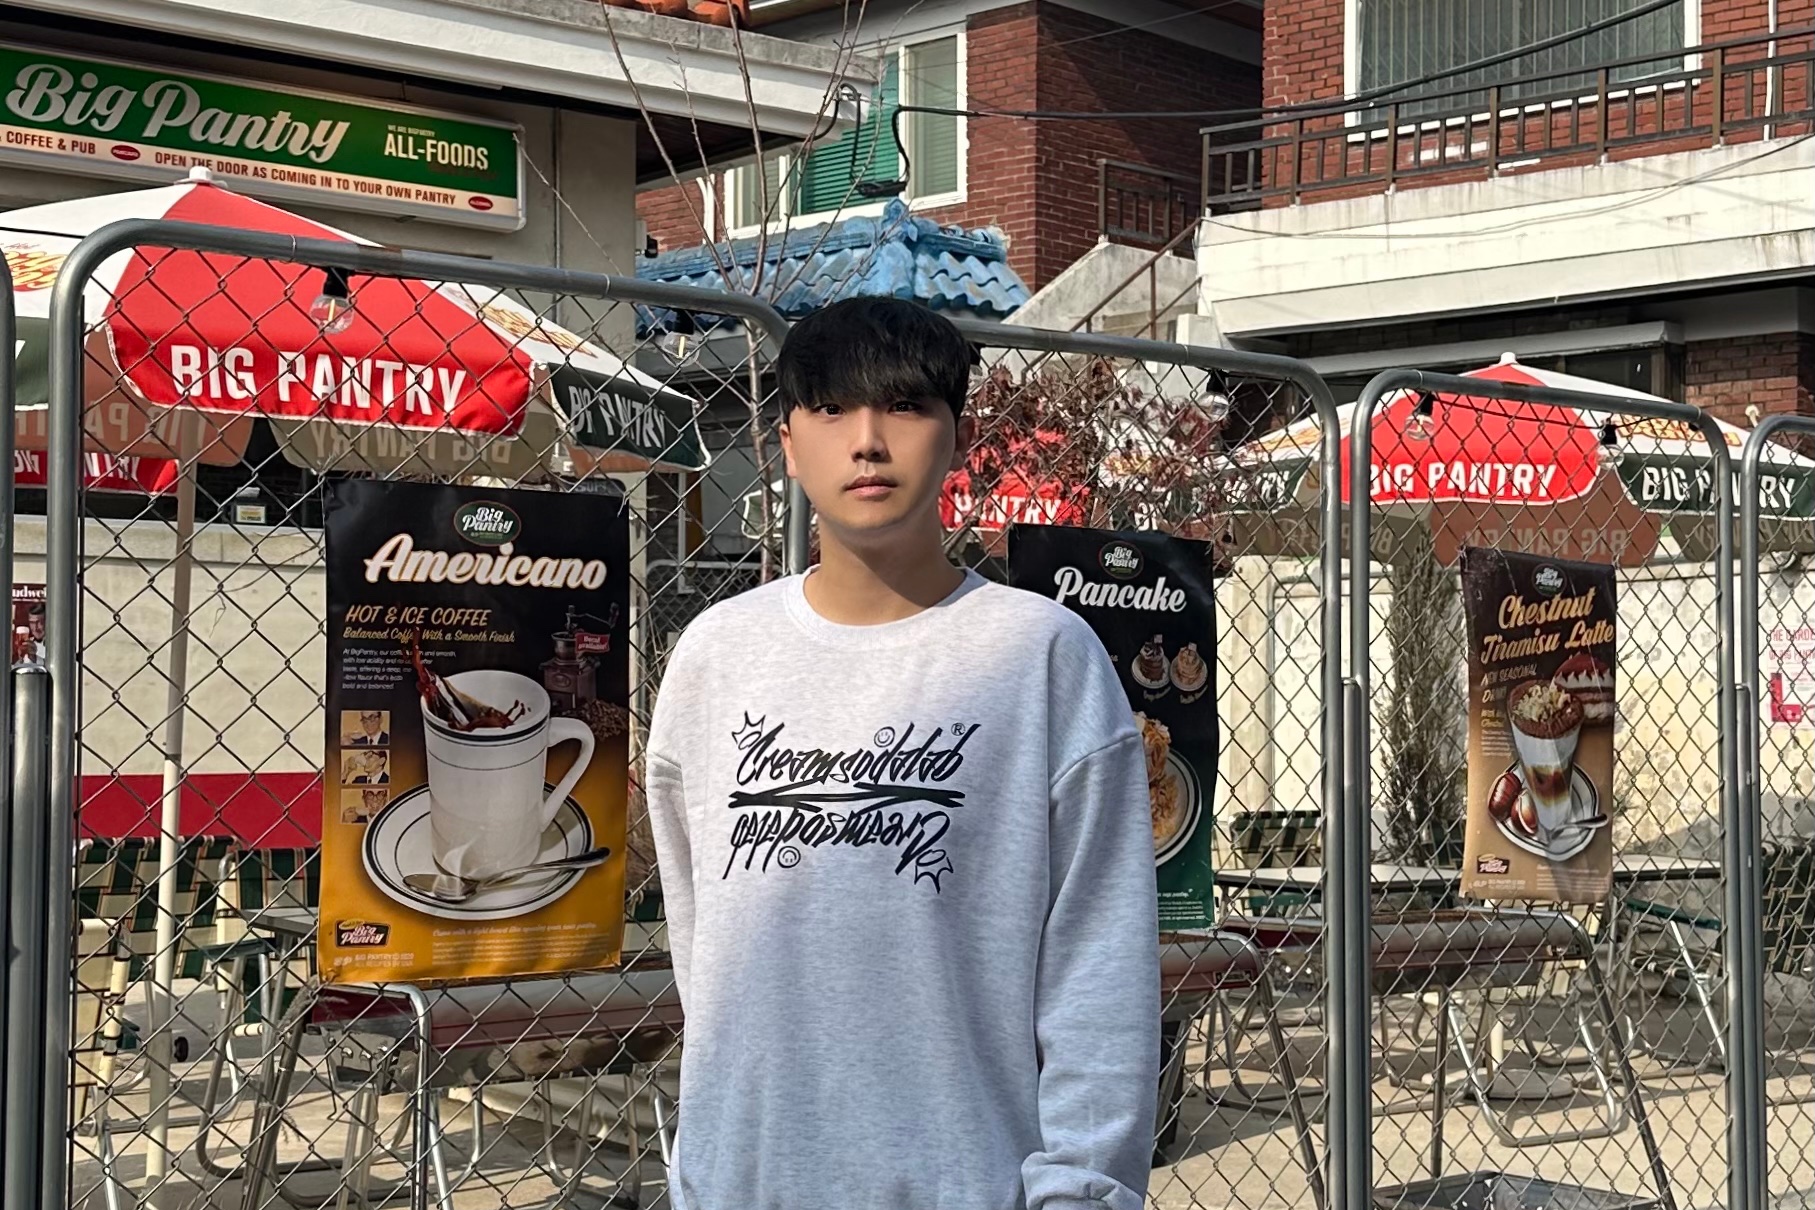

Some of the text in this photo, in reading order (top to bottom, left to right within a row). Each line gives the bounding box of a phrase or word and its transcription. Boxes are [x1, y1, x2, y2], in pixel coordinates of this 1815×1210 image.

[6, 64, 351, 163] Big Pantry
[6, 130, 54, 149] COFFEE
[57, 138, 67, 151] &
[71, 140, 97, 155] PUB
[384, 132, 489, 171] ALL-FOODS
[155, 151, 187, 168] OPEN
[190, 157, 213, 170] THE
[216, 160, 249, 177] DOOR
[252, 166, 268, 179] AS
[271, 168, 317, 187] COMING
[320, 175, 333, 188] IN
[336, 177, 350, 190] TO
[353, 180, 383, 196] YOUR
[386, 185, 412, 200] OWN
[415, 189, 457, 206] PANTRY
[170, 345, 467, 416] BIG PANTRY
[1428, 460, 1557, 498] PANTRY
[1642, 466, 1690, 501] BIG
[476, 506, 504, 522] Big
[363, 533, 608, 591] Americano
[1054, 566, 1188, 613] Pancake
[1498, 586, 1597, 630] Chestnut
[342, 627, 516, 644] Balanced Coffe With a Smooth Finish
[344, 604, 493, 627] HOT & ICE COFFEE
[1480, 618, 1615, 665] Tiramisu Latte
